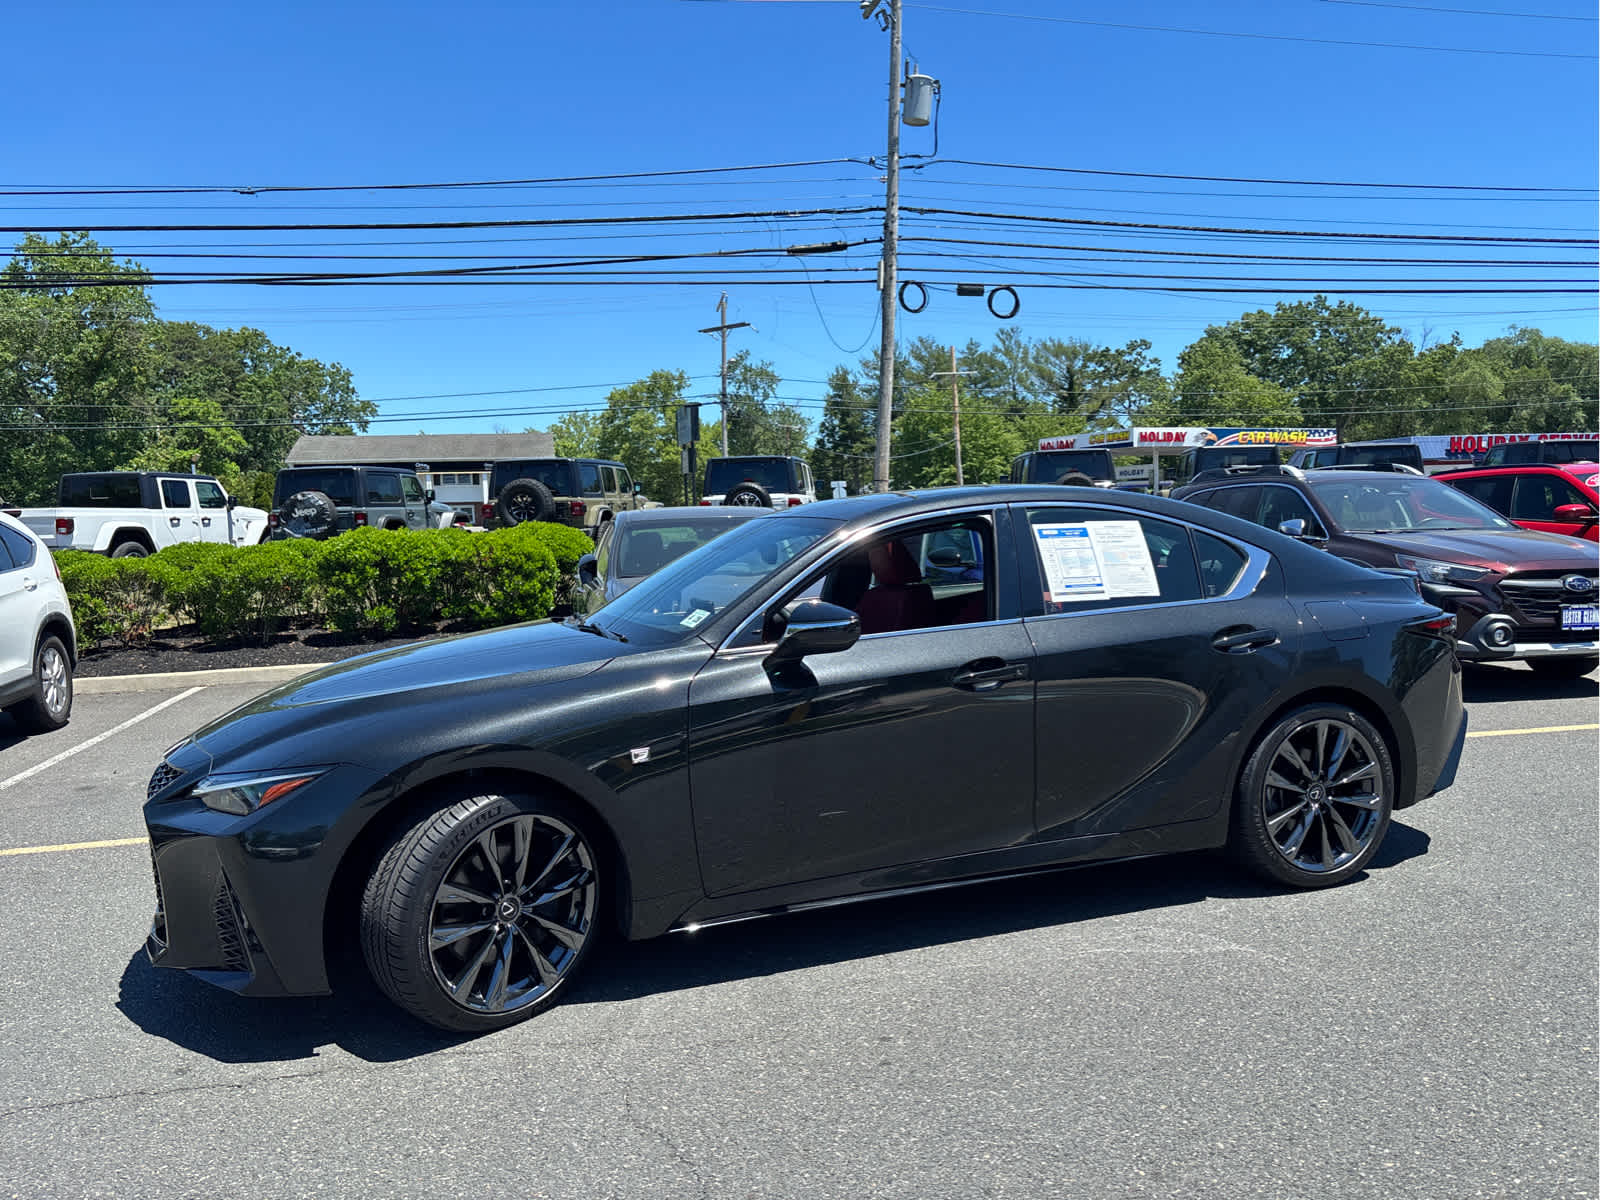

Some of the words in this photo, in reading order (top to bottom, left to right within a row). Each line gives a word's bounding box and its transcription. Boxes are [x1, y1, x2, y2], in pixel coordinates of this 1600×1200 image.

[1139, 431, 1187, 443] HOLIDAY
[1237, 431, 1265, 444] CAR
[1265, 431, 1307, 443] WASH
[1040, 438, 1075, 450] HOLIDAY
[1119, 468, 1144, 476] HOLIDAY
[291, 507, 317, 518] Jeep
